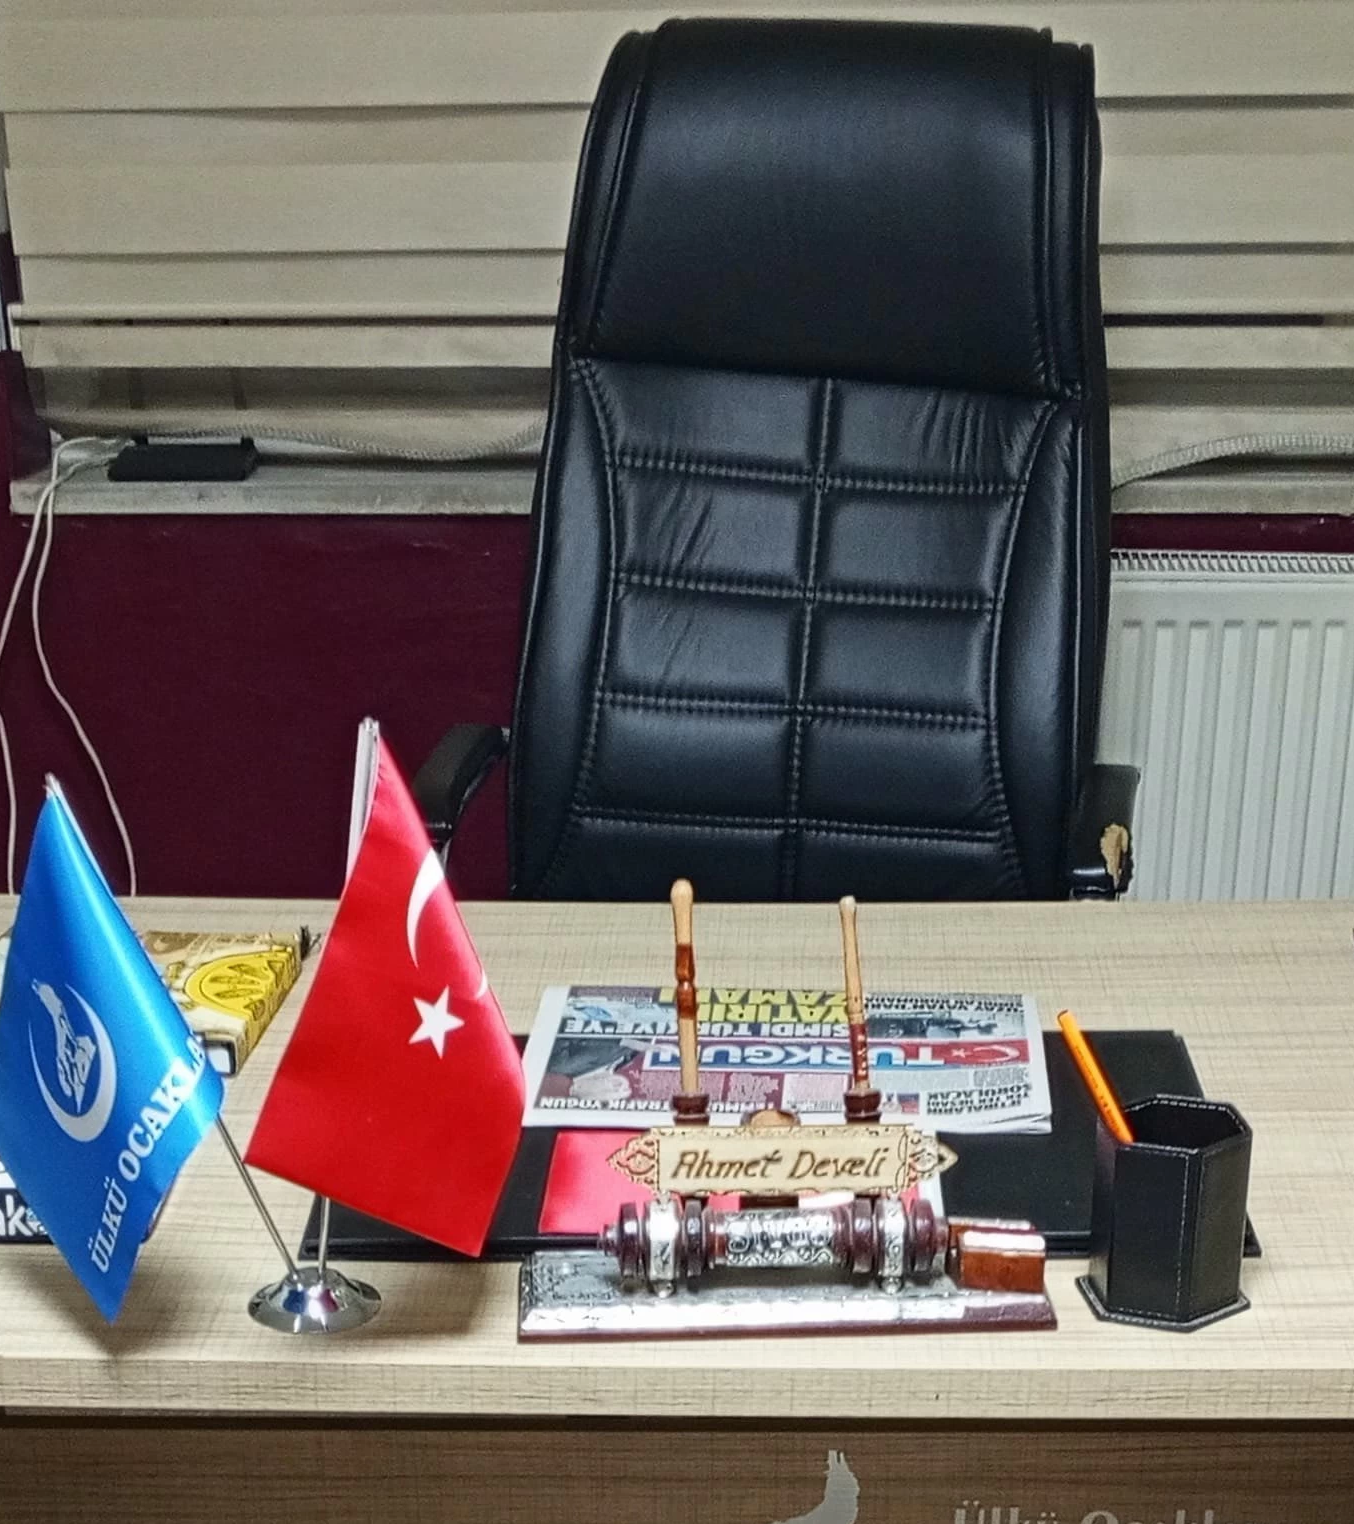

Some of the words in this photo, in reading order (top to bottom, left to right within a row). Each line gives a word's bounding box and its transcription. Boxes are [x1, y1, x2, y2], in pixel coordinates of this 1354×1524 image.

[670, 1149, 783, 1179] Ahmet
[787, 1147, 890, 1180] Develi
[88, 1177, 128, 1273] ÜLKÜ
